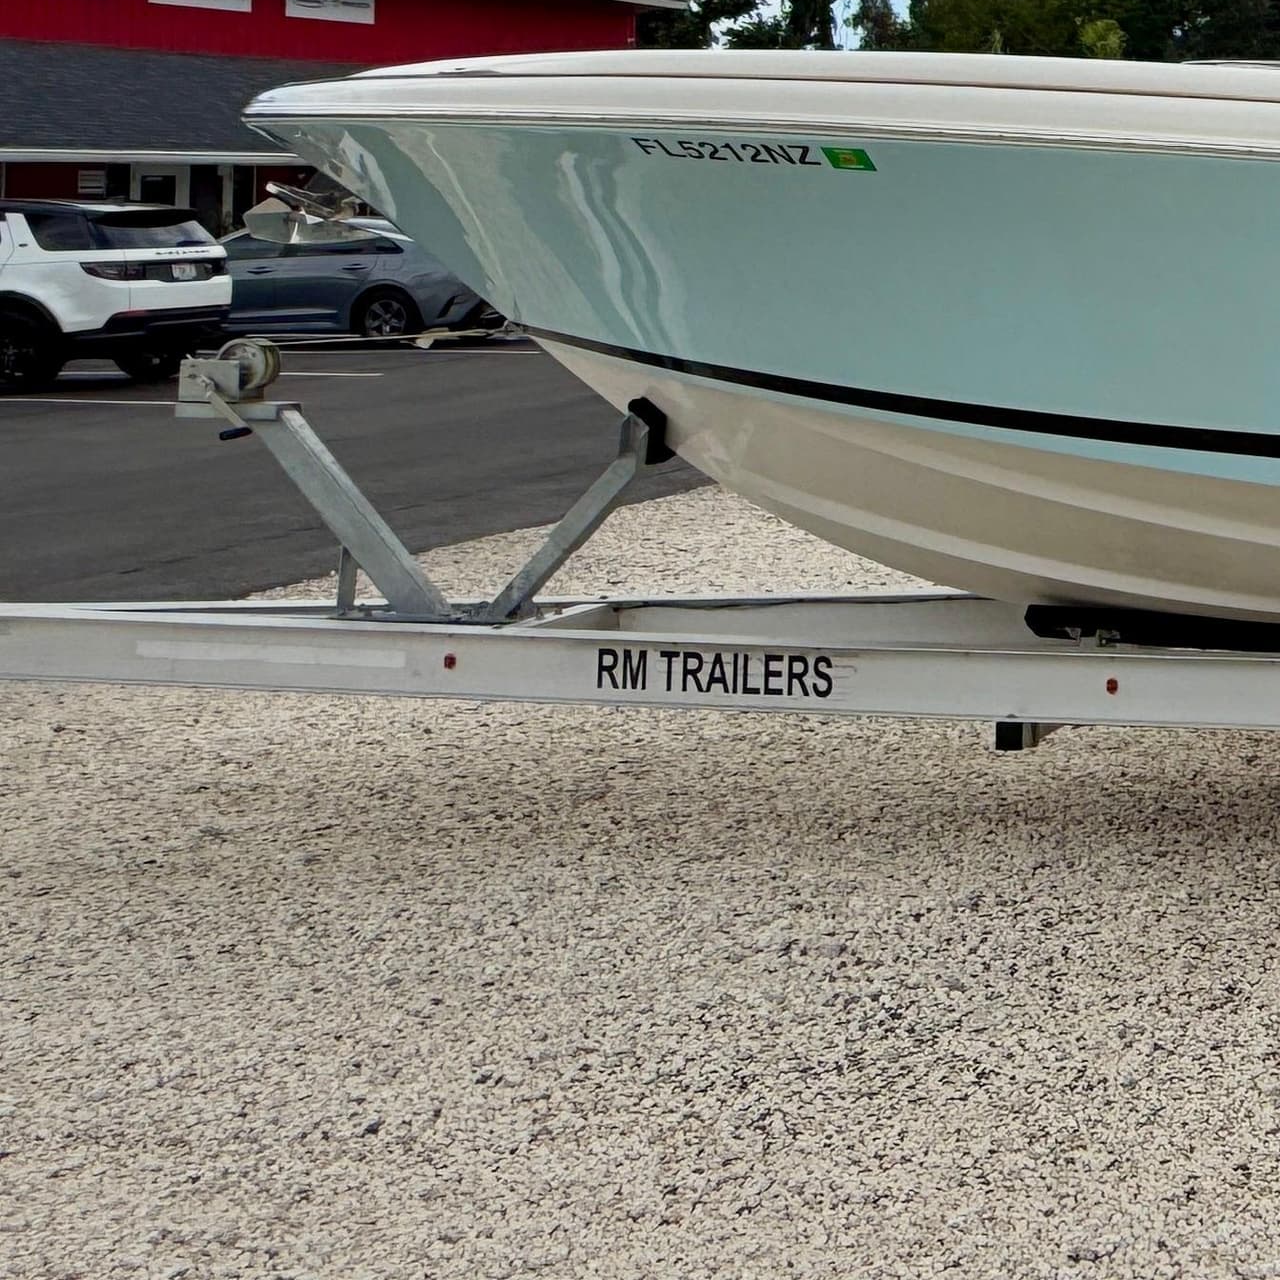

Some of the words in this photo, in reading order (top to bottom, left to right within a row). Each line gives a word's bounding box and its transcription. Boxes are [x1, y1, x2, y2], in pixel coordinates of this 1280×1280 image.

[631, 136, 823, 166] FL5212NZ
[596, 647, 648, 691] RM
[659, 650, 834, 699] TRAILERS
